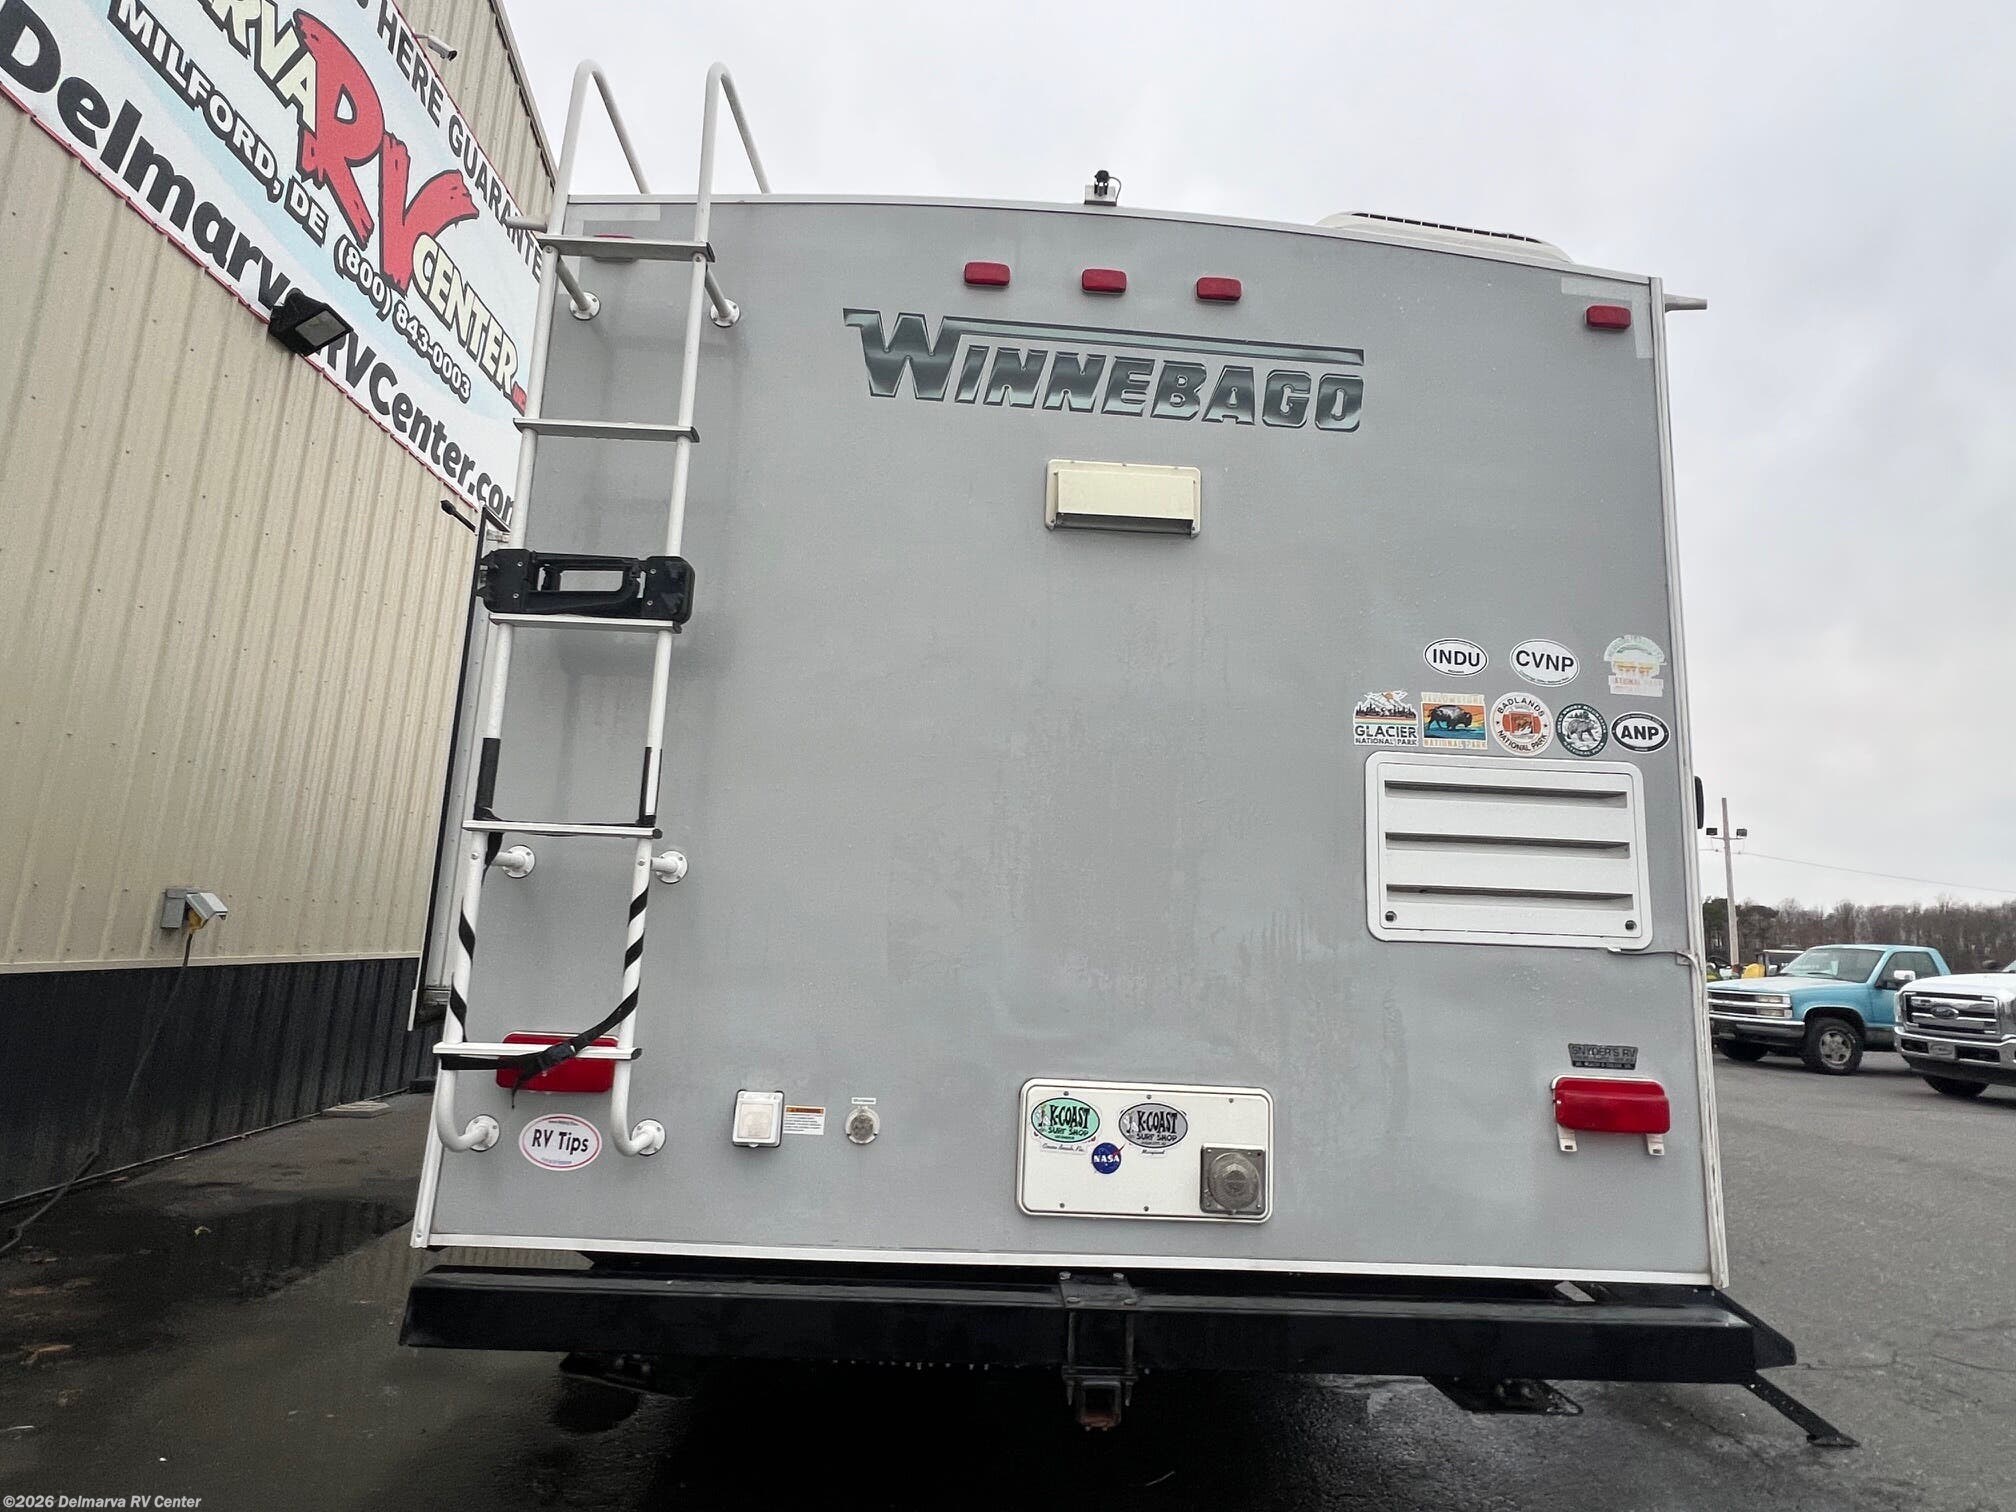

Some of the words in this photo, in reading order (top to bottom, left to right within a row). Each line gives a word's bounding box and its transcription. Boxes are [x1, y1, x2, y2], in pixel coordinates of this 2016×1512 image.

[377, 0, 444, 128] HERE
[107, 0, 284, 203] MILFORD,
[284, 177, 328, 246] DE
[334, 234, 394, 321] (800)
[391, 300, 471, 404] 843-0003
[200, 0, 317, 136] RVA
[412, 231, 519, 398] CENTER
[843, 307, 1364, 433] WINNEBAGO
[1432, 648, 1480, 667] INDU
[1515, 649, 1575, 672] CVNP
[1497, 697, 1544, 717] BADLANDS
[1354, 725, 1418, 739] GLACIER
[1497, 730, 1531, 751] NATIONAL
[1531, 733, 1548, 749] PARK
[1621, 725, 1660, 740] ANP
[1397, 738, 1418, 746] PARK
[1622, 1048, 1636, 1057] RV
[532, 1128, 554, 1148] RV
[558, 1131, 589, 1155] Tips
[1069, 1128, 1089, 1136] SHOP
[1136, 1133, 1154, 1141] SURF
[1156, 1134, 1177, 1142] SHOP
[1094, 1155, 1120, 1163] NASA
